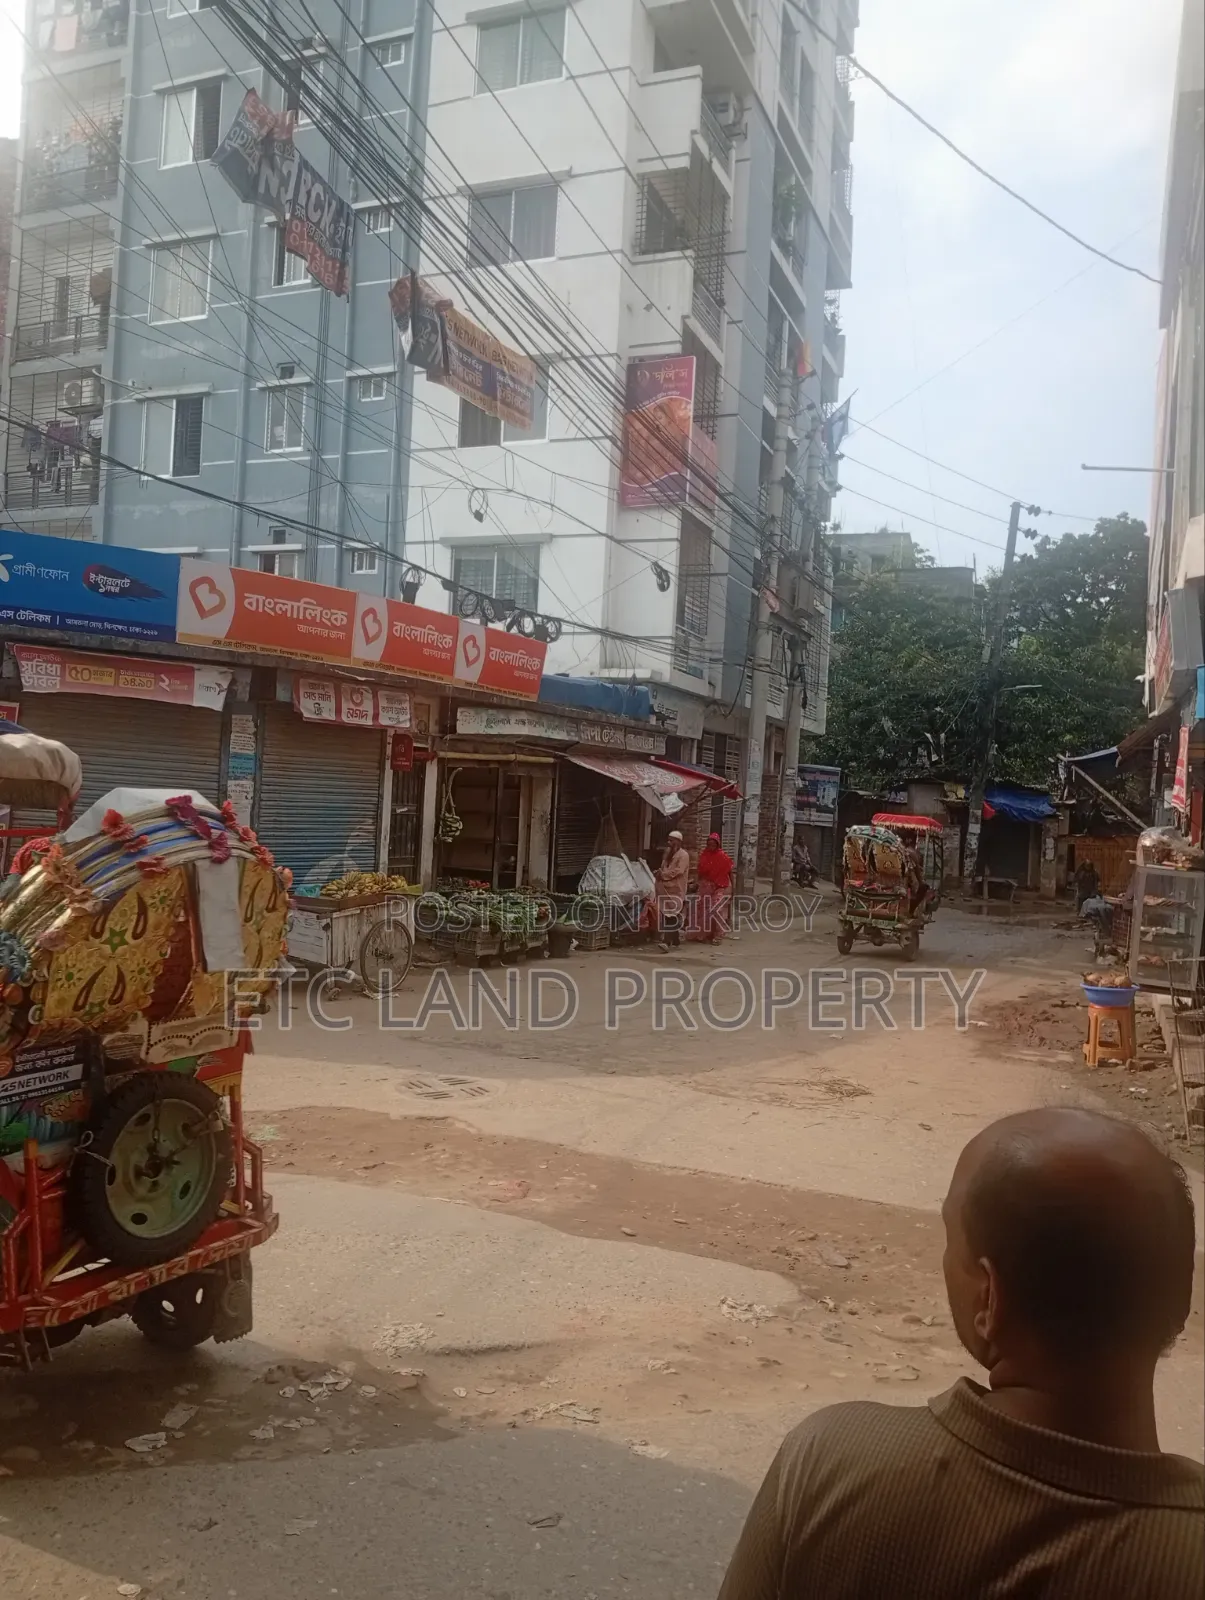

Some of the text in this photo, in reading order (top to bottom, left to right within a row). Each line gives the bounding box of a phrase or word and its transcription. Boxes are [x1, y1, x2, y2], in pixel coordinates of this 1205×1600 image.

[12, 562, 69, 582] গ্রামীণফোন
[89, 572, 131, 588] ইন্টারনেটে
[16, 610, 51, 624] টেলিকম
[244, 592, 348, 627] বাংলালিংক
[392, 621, 454, 649] বাংলালিংক
[489, 646, 541, 670] বাংলালিংক
[20, 659, 61, 676] সুবিধা
[68, 666, 92, 682] ৫০
[20, 674, 60, 688] ডাবল
[123, 677, 152, 689] ১৪.৯০
[159, 673, 170, 692] ২
[347, 707, 369, 721] নগদ
[17, 1070, 70, 1090] NETWORK
